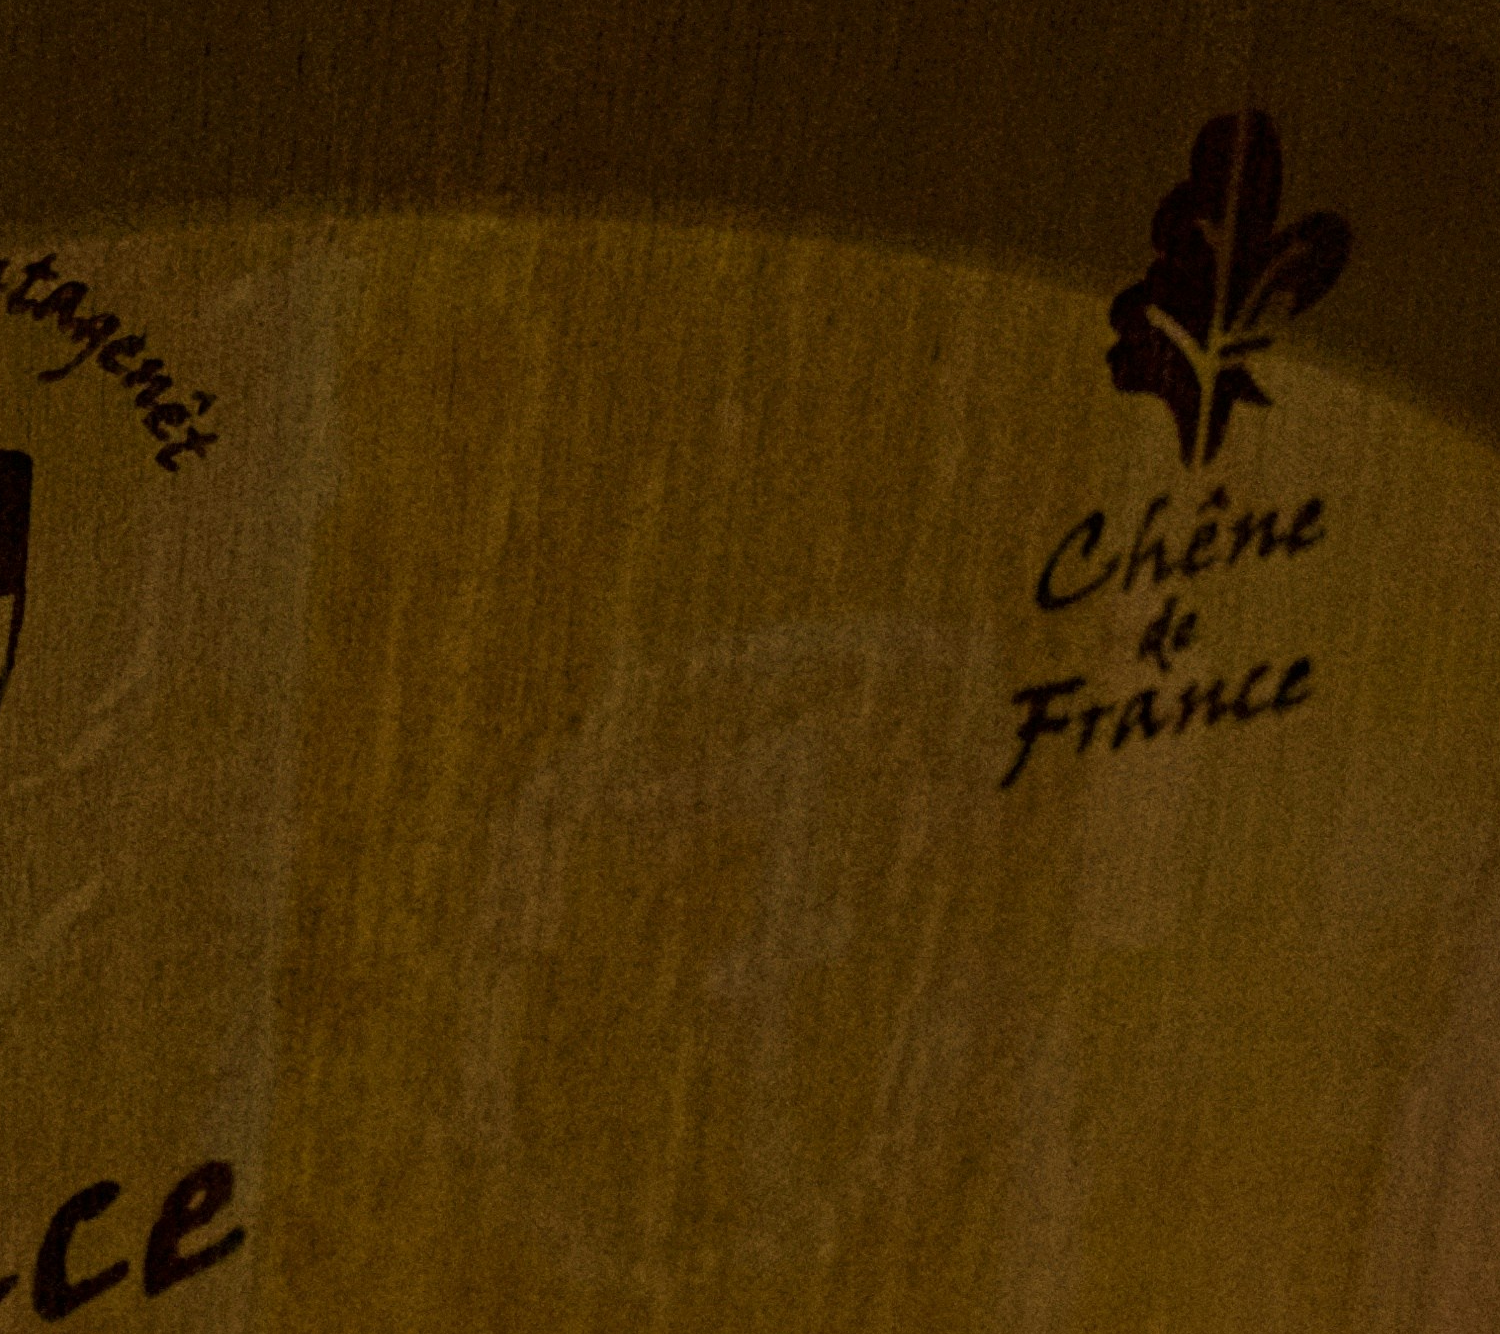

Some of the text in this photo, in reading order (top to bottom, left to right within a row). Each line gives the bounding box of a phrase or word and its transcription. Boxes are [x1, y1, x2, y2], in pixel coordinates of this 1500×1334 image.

[1034, 485, 1326, 612] Chêne
[1138, 596, 1199, 671] de
[1000, 655, 1316, 789] France
